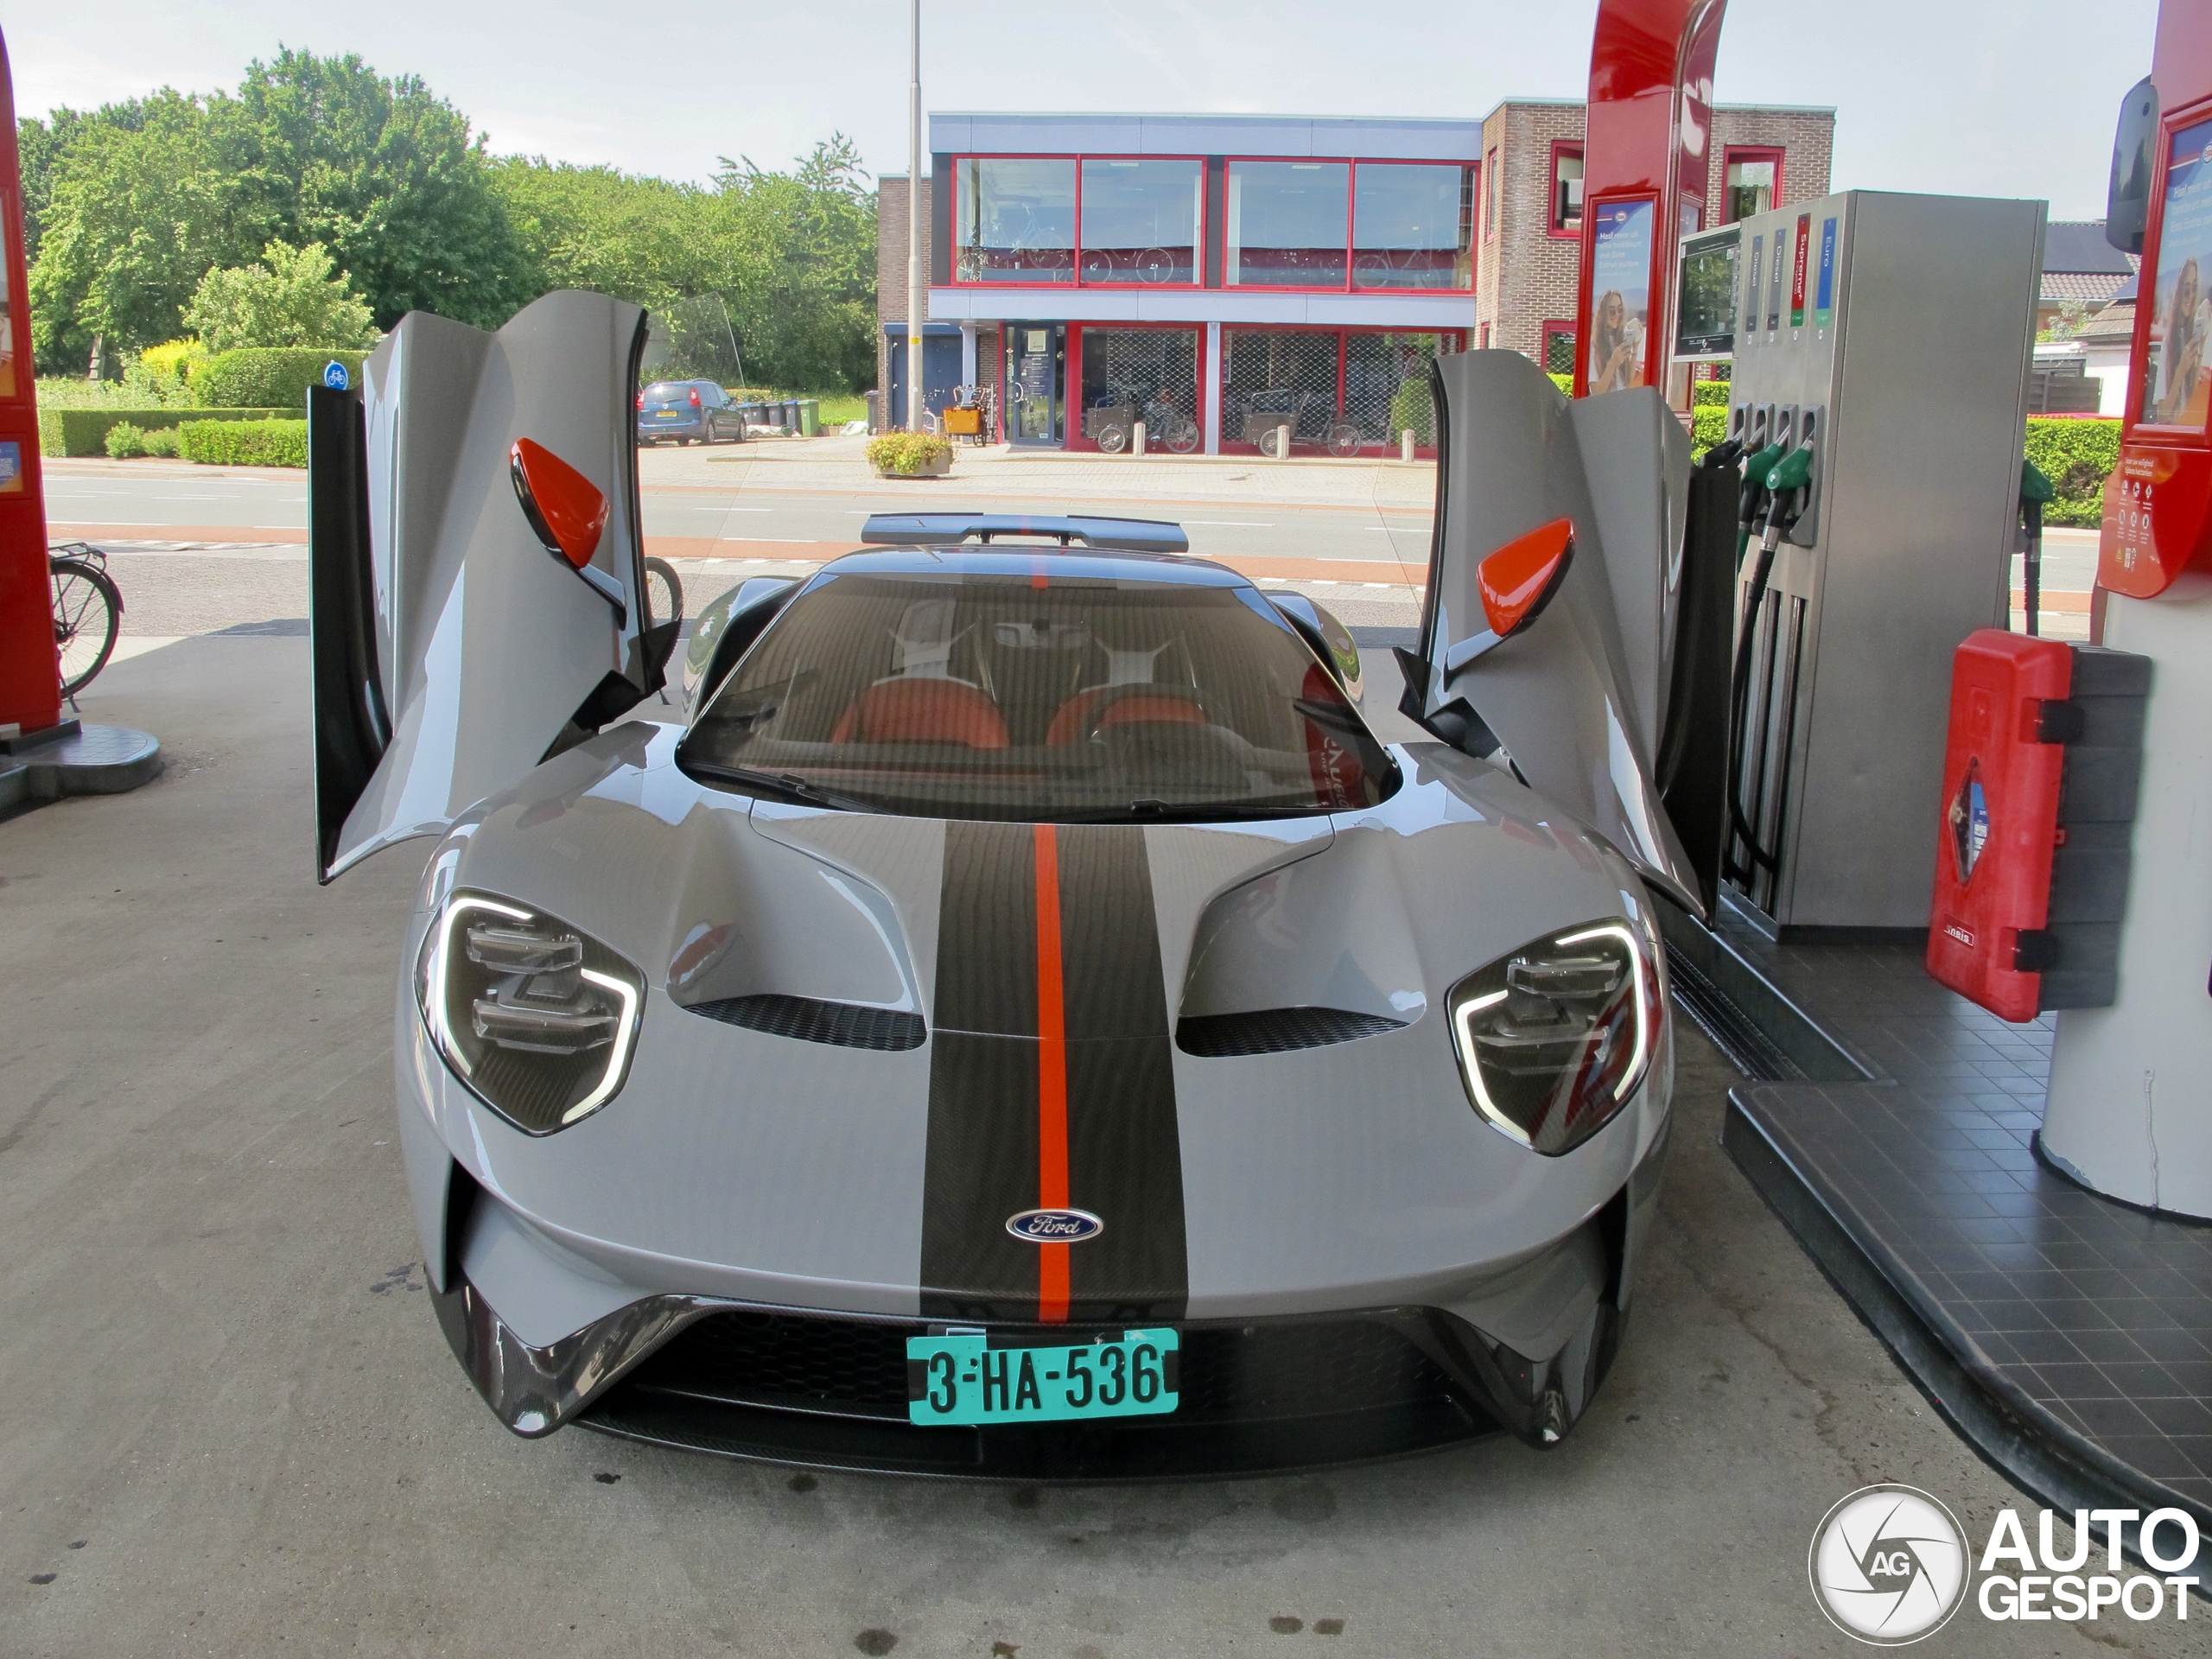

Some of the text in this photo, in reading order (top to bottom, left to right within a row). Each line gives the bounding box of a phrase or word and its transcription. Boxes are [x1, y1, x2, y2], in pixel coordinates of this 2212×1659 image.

[2174, 185, 2187, 198] Haal
[1027, 1215, 1081, 1235] Ford
[928, 1344, 1160, 1413] 3-HA-536
